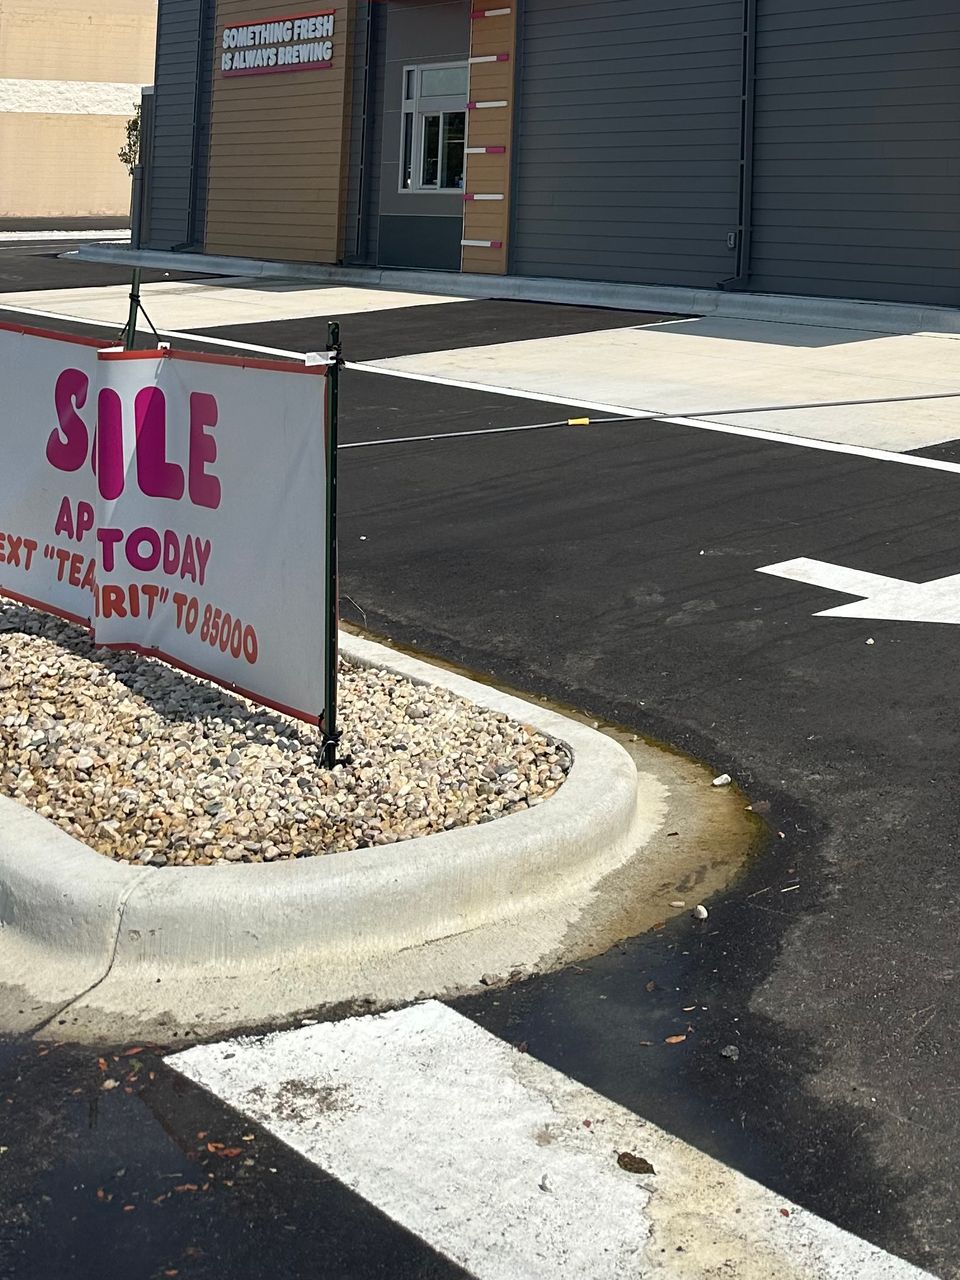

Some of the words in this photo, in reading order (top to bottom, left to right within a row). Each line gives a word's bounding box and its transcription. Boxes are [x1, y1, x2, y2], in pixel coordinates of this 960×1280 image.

[222, 21, 294, 49] SOMETHING
[294, 15, 335, 41] FRESH
[221, 52, 233, 71] IS
[232, 46, 278, 70] ALWAYS
[277, 41, 333, 65] BREWING
[97, 526, 211, 586] TODAY
[0, 532, 38, 571] EXT
[172, 591, 198, 634] TO
[200, 603, 258, 664] 85000
